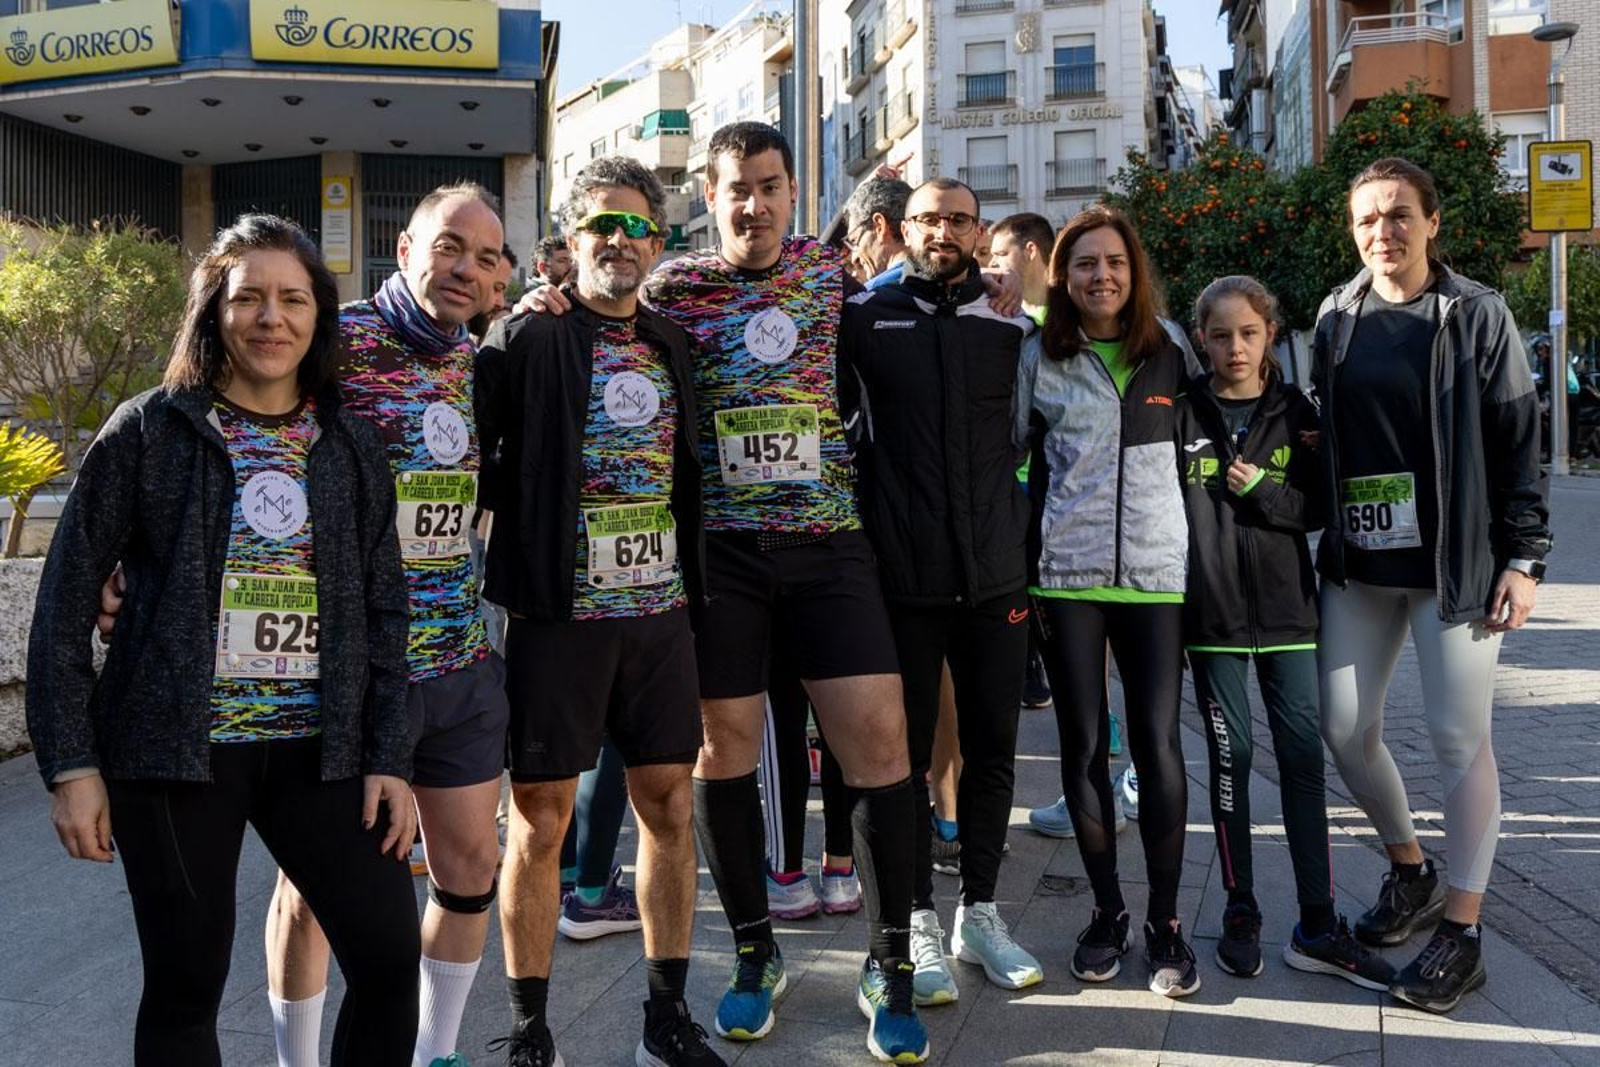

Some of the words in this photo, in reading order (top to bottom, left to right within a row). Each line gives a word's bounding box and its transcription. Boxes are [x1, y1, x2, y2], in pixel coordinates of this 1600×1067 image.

[40, 25, 153, 63] CORREOS
[323, 17, 474, 54] CORREOS
[941, 113, 994, 129] ILUSTRE
[1002, 107, 1060, 125] COLEGIO
[1067, 104, 1123, 120] OFICIAL
[743, 432, 799, 464] 452
[415, 503, 463, 537] 623
[1347, 502, 1393, 533] 690
[615, 531, 663, 568] 624
[234, 591, 243, 604] IV
[245, 591, 279, 608] CARRERA
[282, 593, 313, 609] POPULAR
[251, 578, 270, 591] SAN
[272, 580, 295, 593] JUAN
[254, 611, 320, 654] 625
